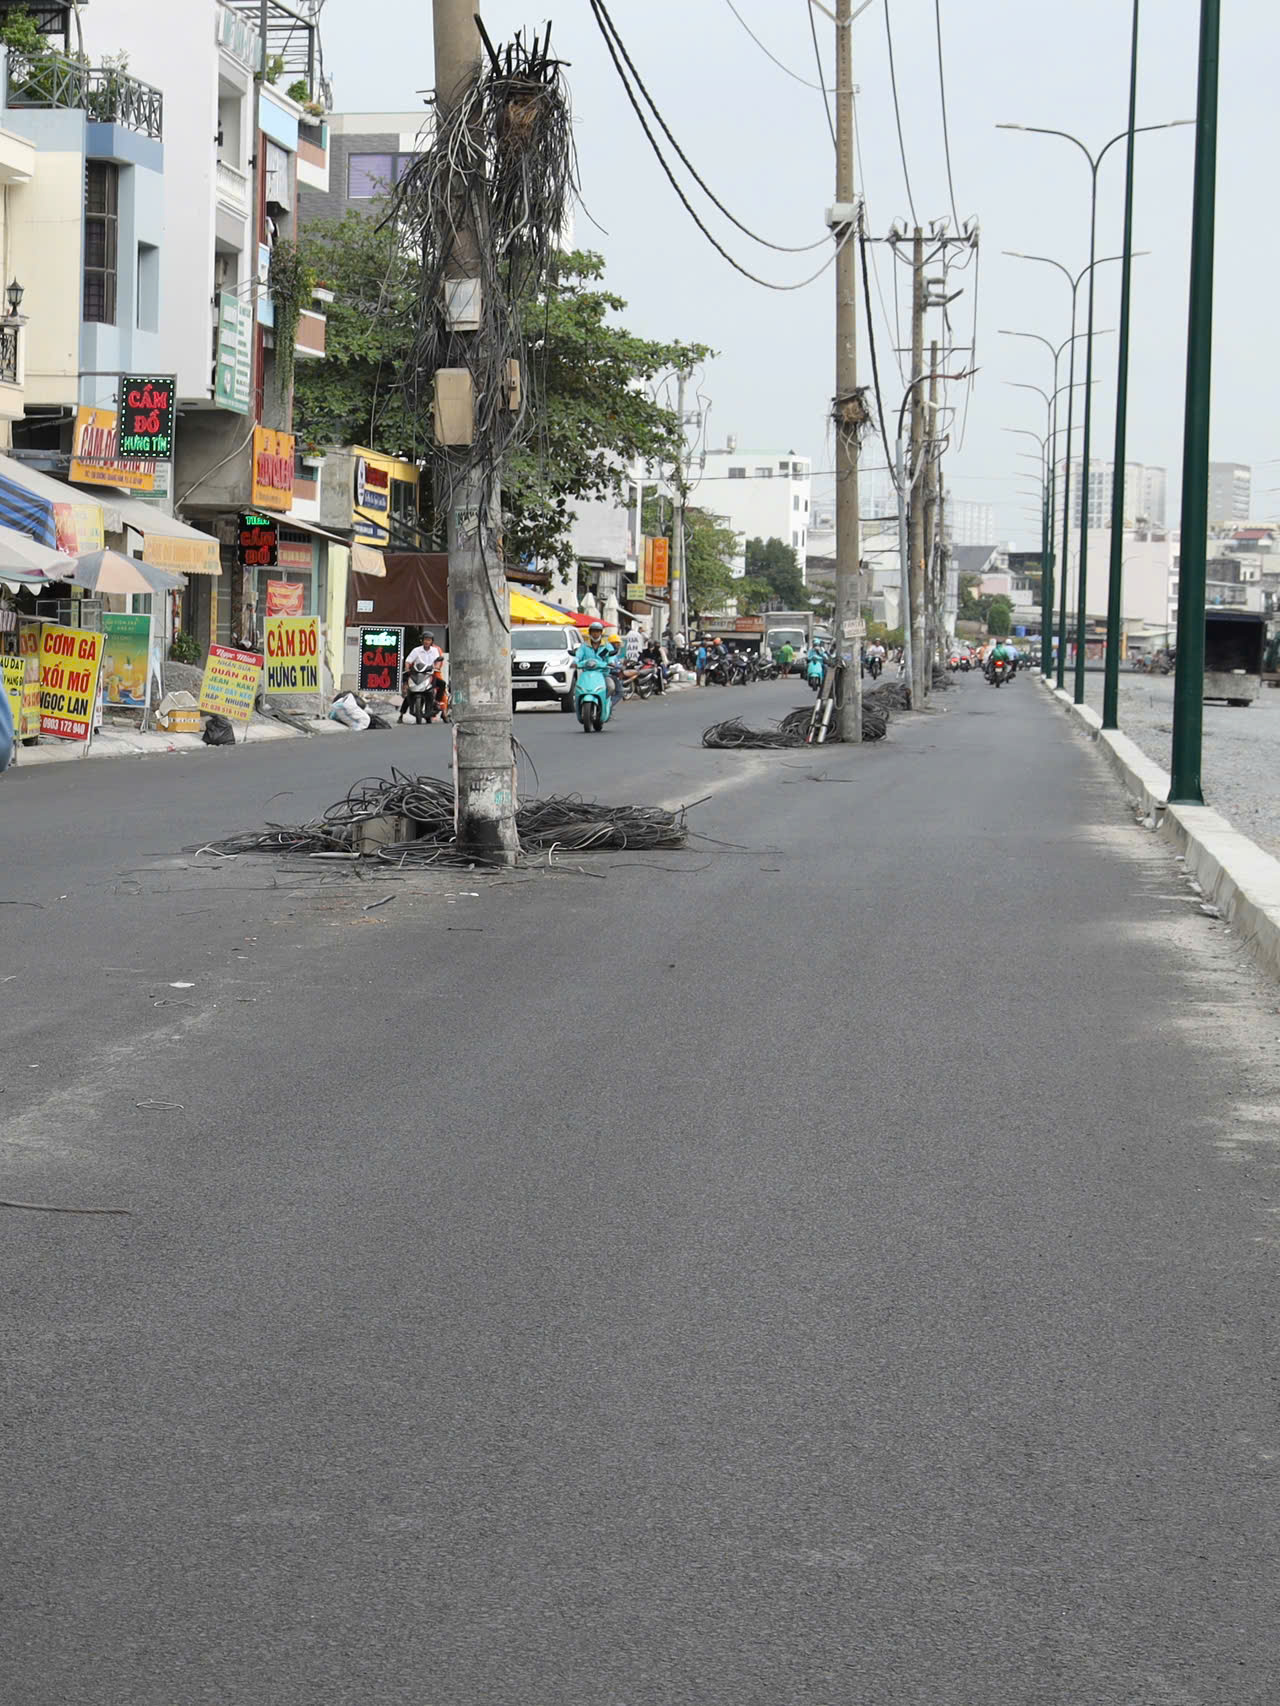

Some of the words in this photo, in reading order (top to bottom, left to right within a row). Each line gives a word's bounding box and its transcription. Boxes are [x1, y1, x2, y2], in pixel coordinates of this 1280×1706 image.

[151, 434, 168, 452] TÍN
[43, 633, 76, 657] CƠM
[78, 636, 97, 661] GÀ
[267, 620, 296, 657] CẦM
[298, 620, 317, 657] ĐỒ
[42, 661, 65, 689] XỐI
[67, 668, 91, 694] MỠ
[209, 675, 230, 686] JEAN
[267, 661, 297, 688] HƯNG
[299, 660, 318, 687] TÍN
[40, 691, 65, 715] NGỌC
[67, 696, 89, 716] LAN
[60, 719, 72, 733] 172
